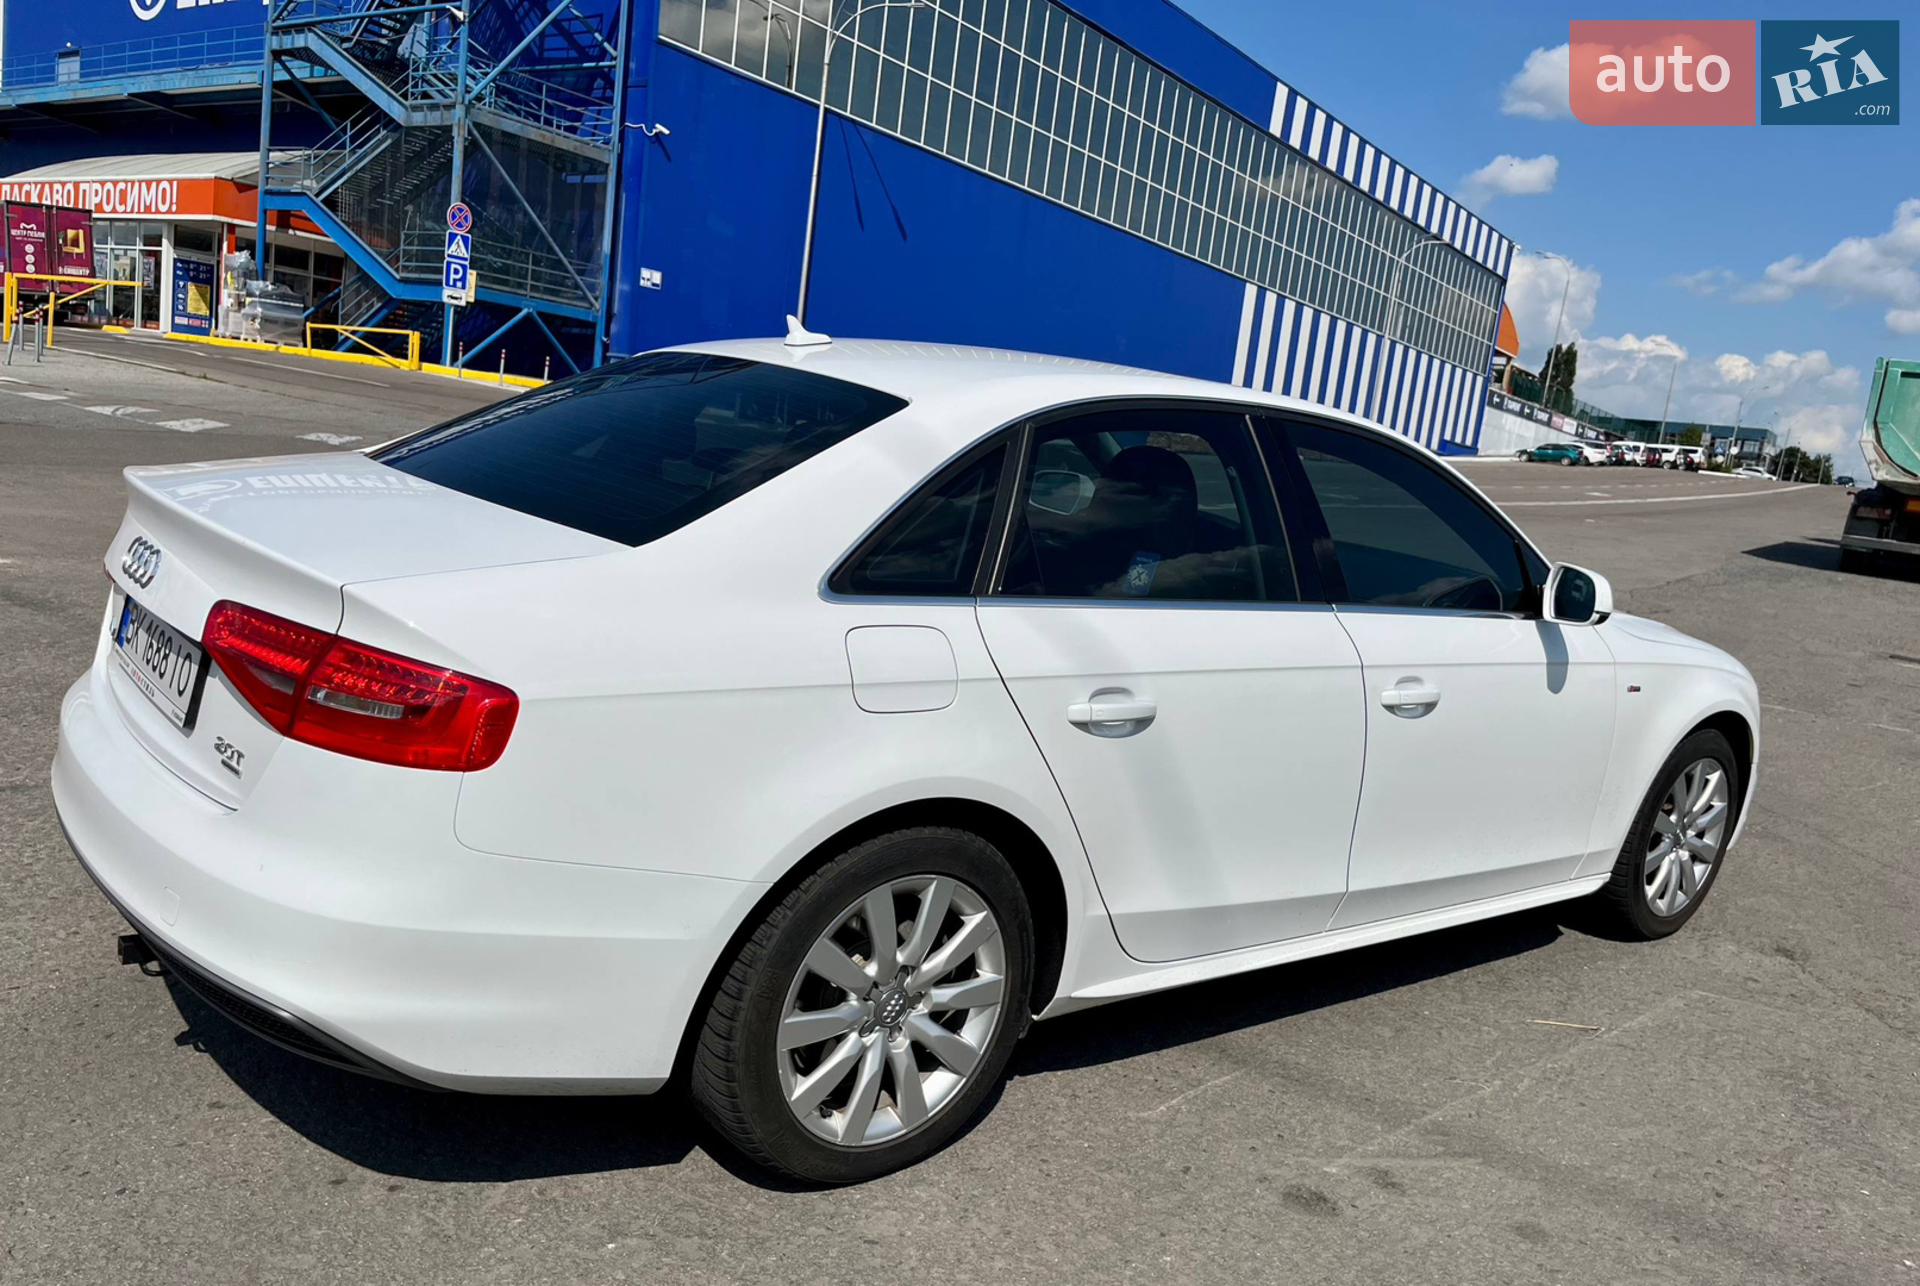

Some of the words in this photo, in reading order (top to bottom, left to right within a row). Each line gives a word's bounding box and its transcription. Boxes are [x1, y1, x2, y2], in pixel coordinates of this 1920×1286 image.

[78, 180, 178, 213] ПРОСИМО!
[449, 263, 464, 287] P
[142, 619, 173, 680] 1688
